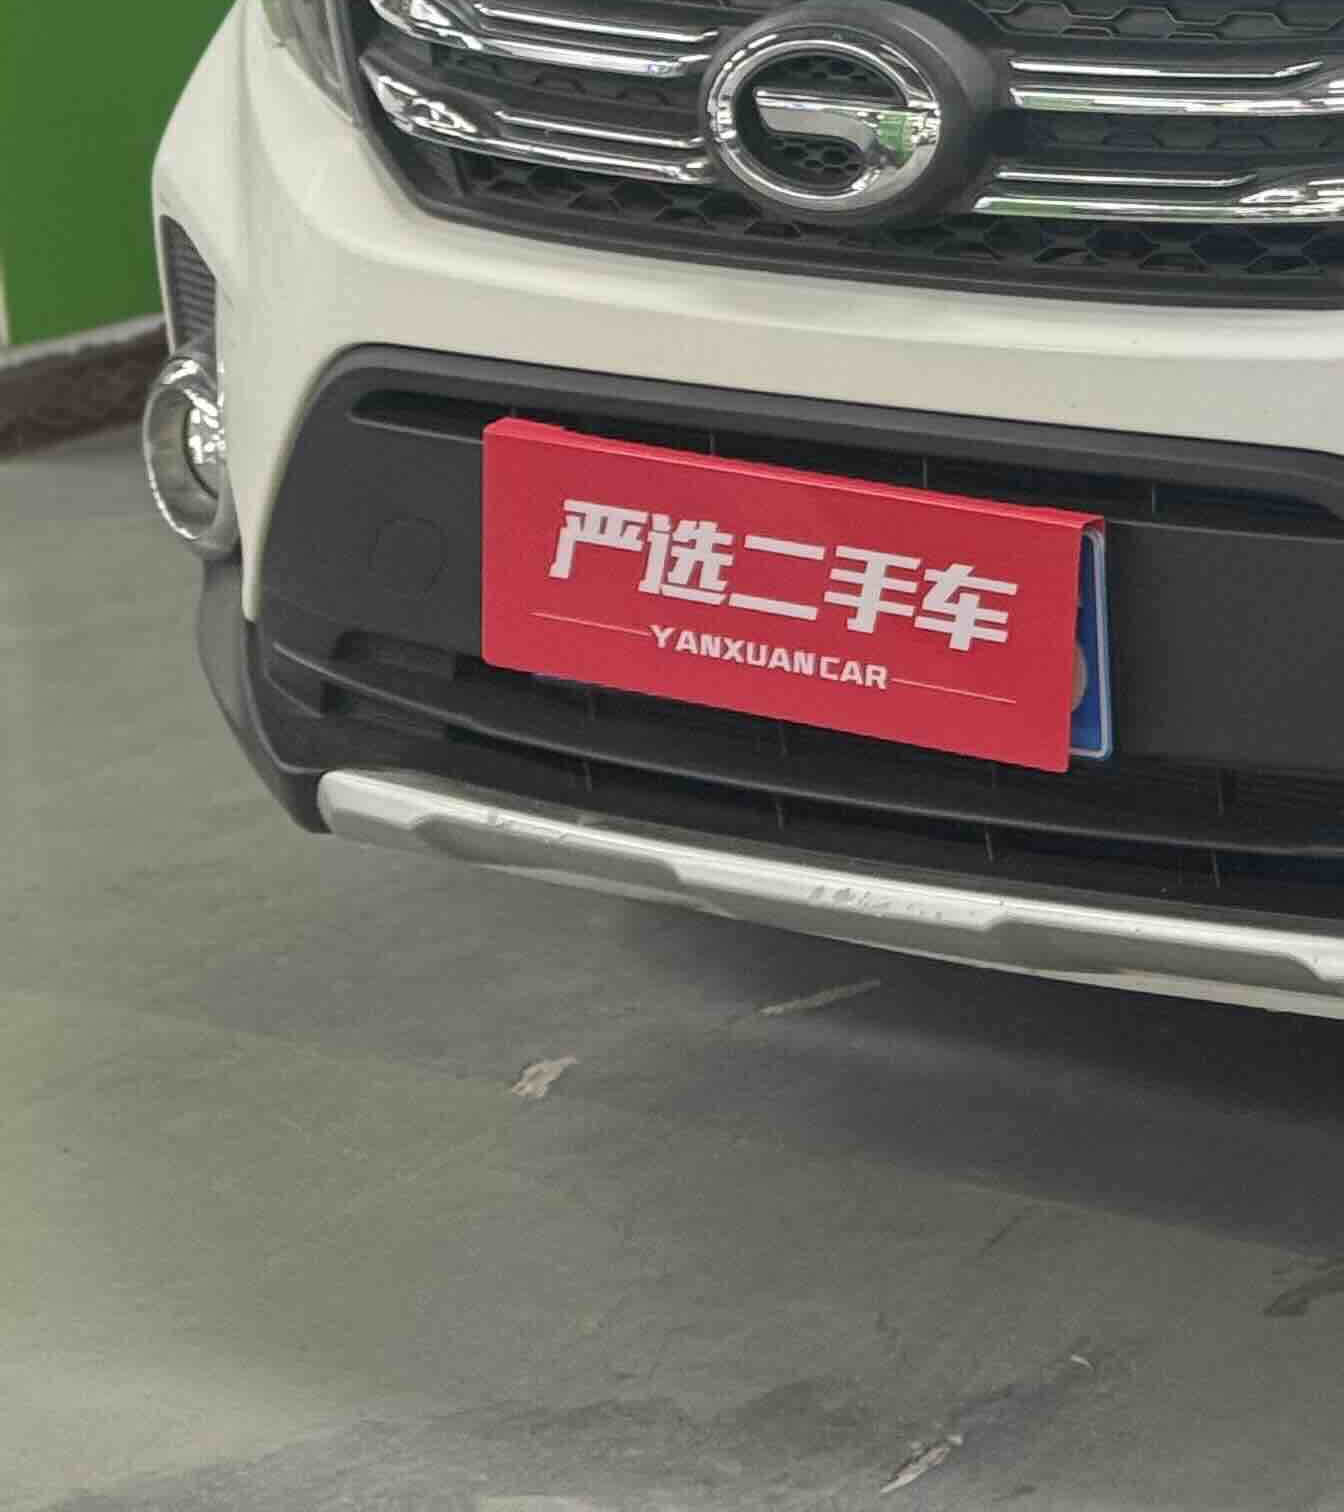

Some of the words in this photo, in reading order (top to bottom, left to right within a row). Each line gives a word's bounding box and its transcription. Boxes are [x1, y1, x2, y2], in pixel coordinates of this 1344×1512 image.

[548, 498, 1019, 652] 严选二手车
